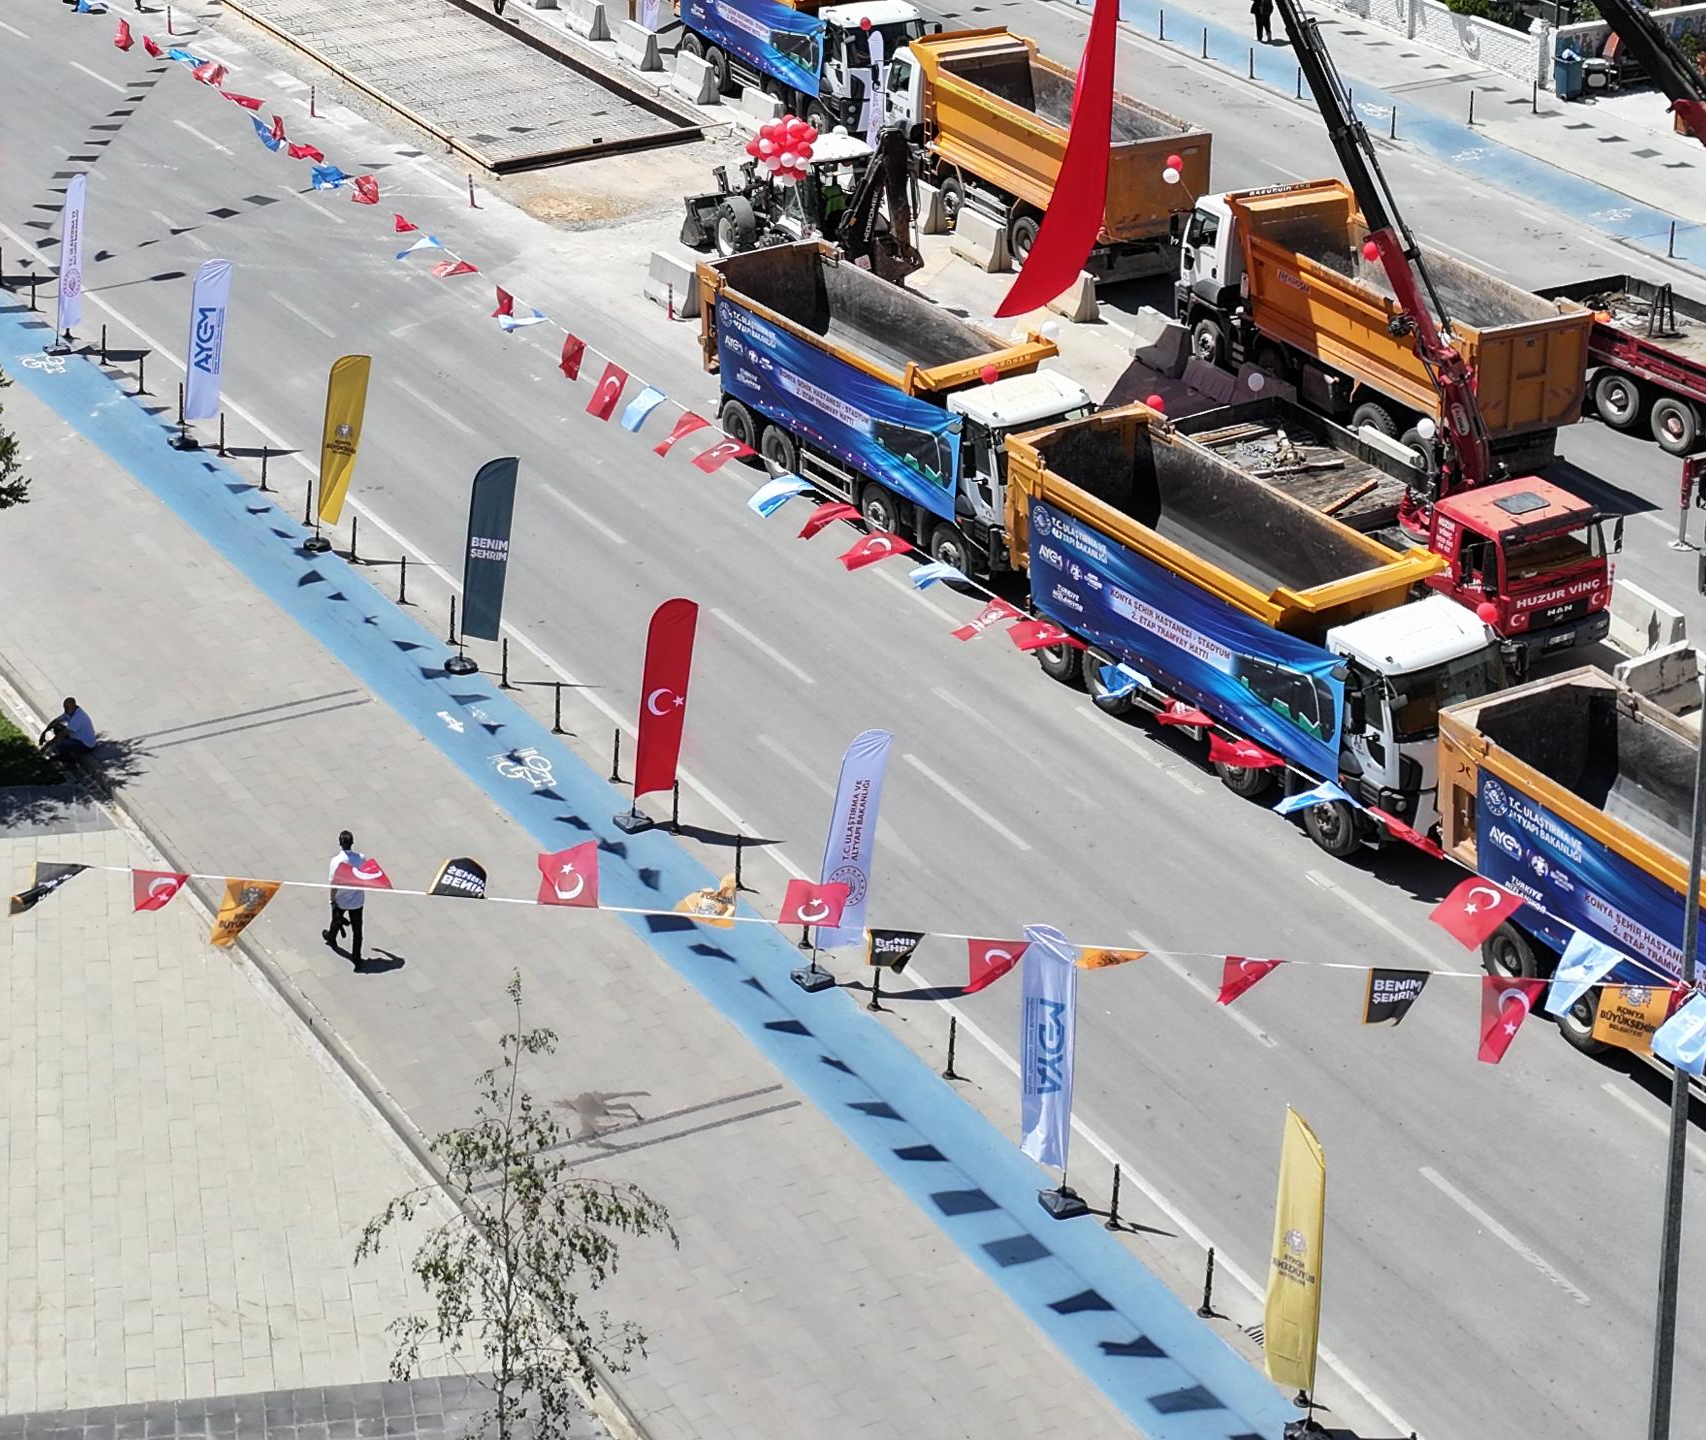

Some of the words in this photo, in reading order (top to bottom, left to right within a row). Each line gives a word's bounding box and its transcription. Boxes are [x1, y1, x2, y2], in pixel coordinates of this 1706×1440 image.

[194, 307, 217, 374] AYGM
[471, 536, 509, 551] BENİM
[1516, 589, 1566, 609] HUZUR
[1570, 578, 1601, 595] VİNÇ
[1547, 604, 1573, 617] MAN
[1109, 588, 1132, 607] KONYA
[1198, 636, 1231, 659] STADYUM
[1139, 616, 1156, 630] ETAP
[1156, 625, 1188, 649] TRAMVAY
[845, 792, 860, 844] ULAŞTIRMA
[855, 780, 863, 791] VE
[1508, 796, 1523, 814] T.C.
[1523, 806, 1570, 845] ULAŞTIRMA
[851, 826, 862, 861] ALTYAPI
[1540, 827, 1582, 864] BAKANLIĞI
[1584, 892, 1614, 920] KONYA
[1644, 928, 1685, 965] HASTANE
[1612, 925, 1620, 936] 2.
[1623, 931, 1645, 953] ETAP
[1646, 943, 1684, 979] TRAMVA
[1374, 978, 1423, 992] BENİM
[1617, 1006, 1645, 1020] KONYA
